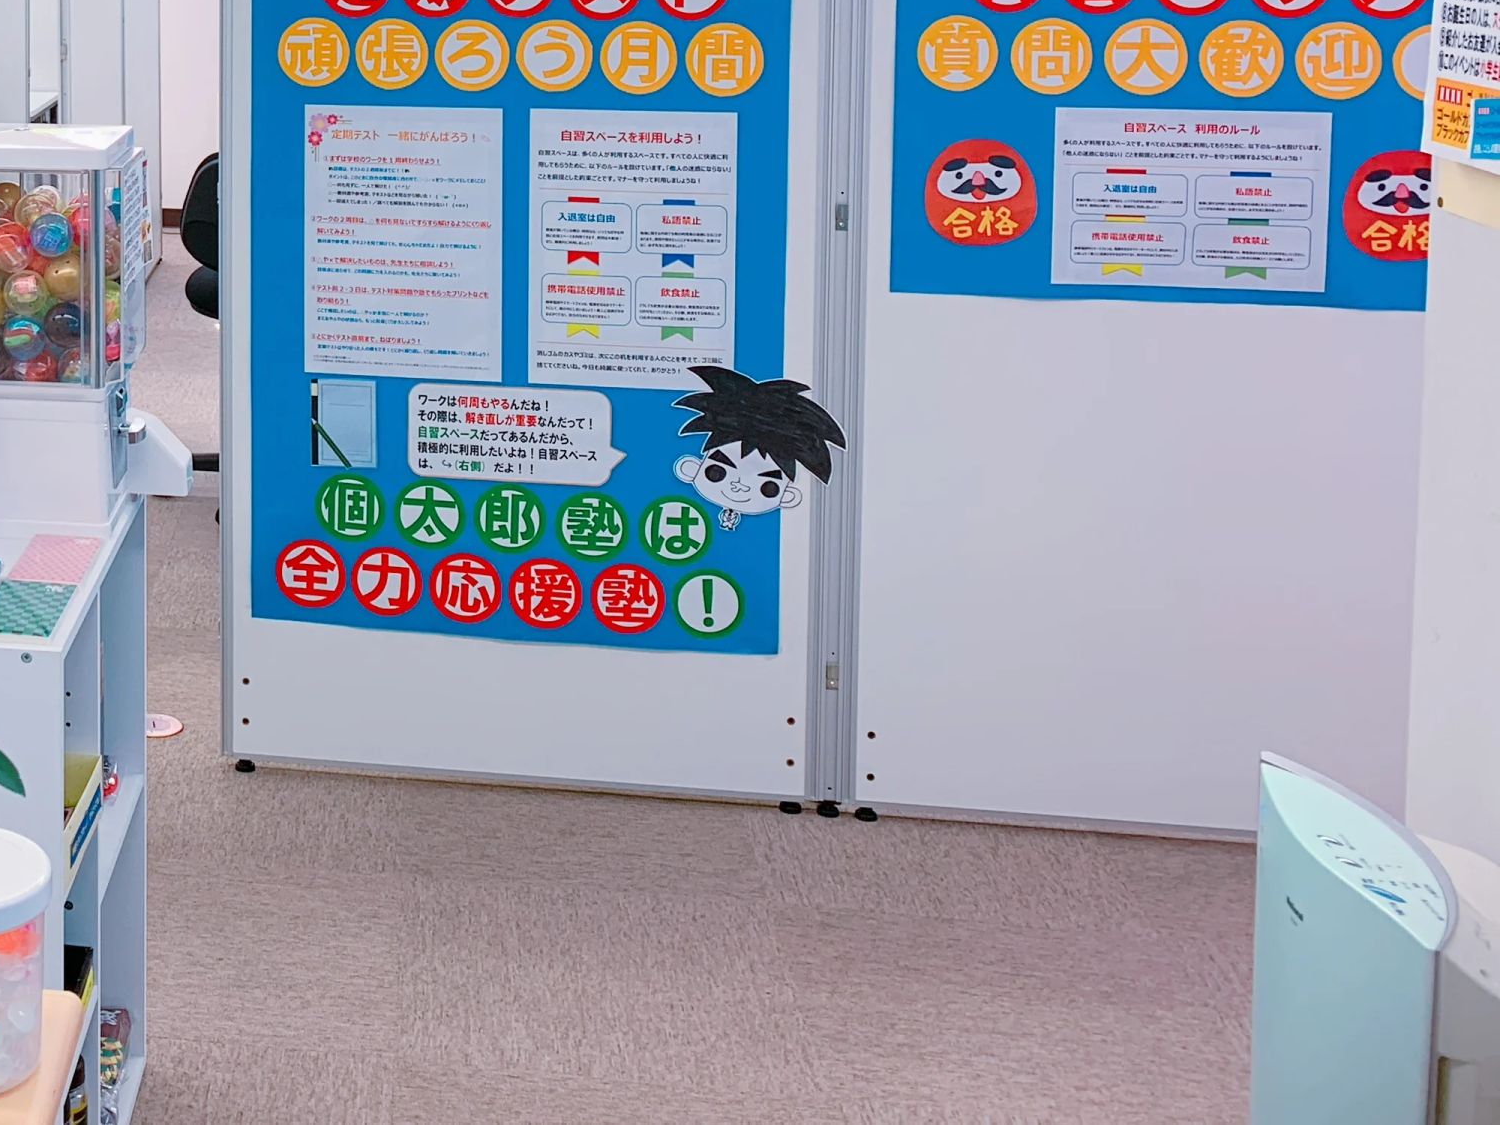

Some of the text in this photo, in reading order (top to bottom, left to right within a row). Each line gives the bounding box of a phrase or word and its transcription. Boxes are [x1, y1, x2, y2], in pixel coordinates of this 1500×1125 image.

[278, 17, 765, 98] 頑張ろう月間
[917, 14, 1382, 101] 質問大歓迎
[331, 129, 380, 141] 定期テスト
[561, 129, 702, 144] 自習スペースを利用しよう！
[1124, 122, 1261, 135] 自習スペース 利用のルール
[1103, 184, 1157, 194] 入退室は自由
[558, 212, 616, 223] 入退室は自由
[661, 215, 702, 225] 私語禁止
[942, 206, 1019, 239] 合格
[1232, 235, 1270, 246] 飲食禁止
[547, 284, 625, 296] 携帯電話使用禁止
[660, 287, 700, 298] 飲食禁止
[418, 394, 549, 411] ワークは何周もやるんだね！
[417, 410, 593, 429] その際は、解き直しが重要なんだって！
[418, 426, 573, 445] 自習スペースだってあるんだから、
[417, 441, 597, 461] 積極的に利用したいよね！自習スペース
[314, 472, 711, 567] 個太郎塾は
[275, 538, 745, 641] 全力応援塾！
